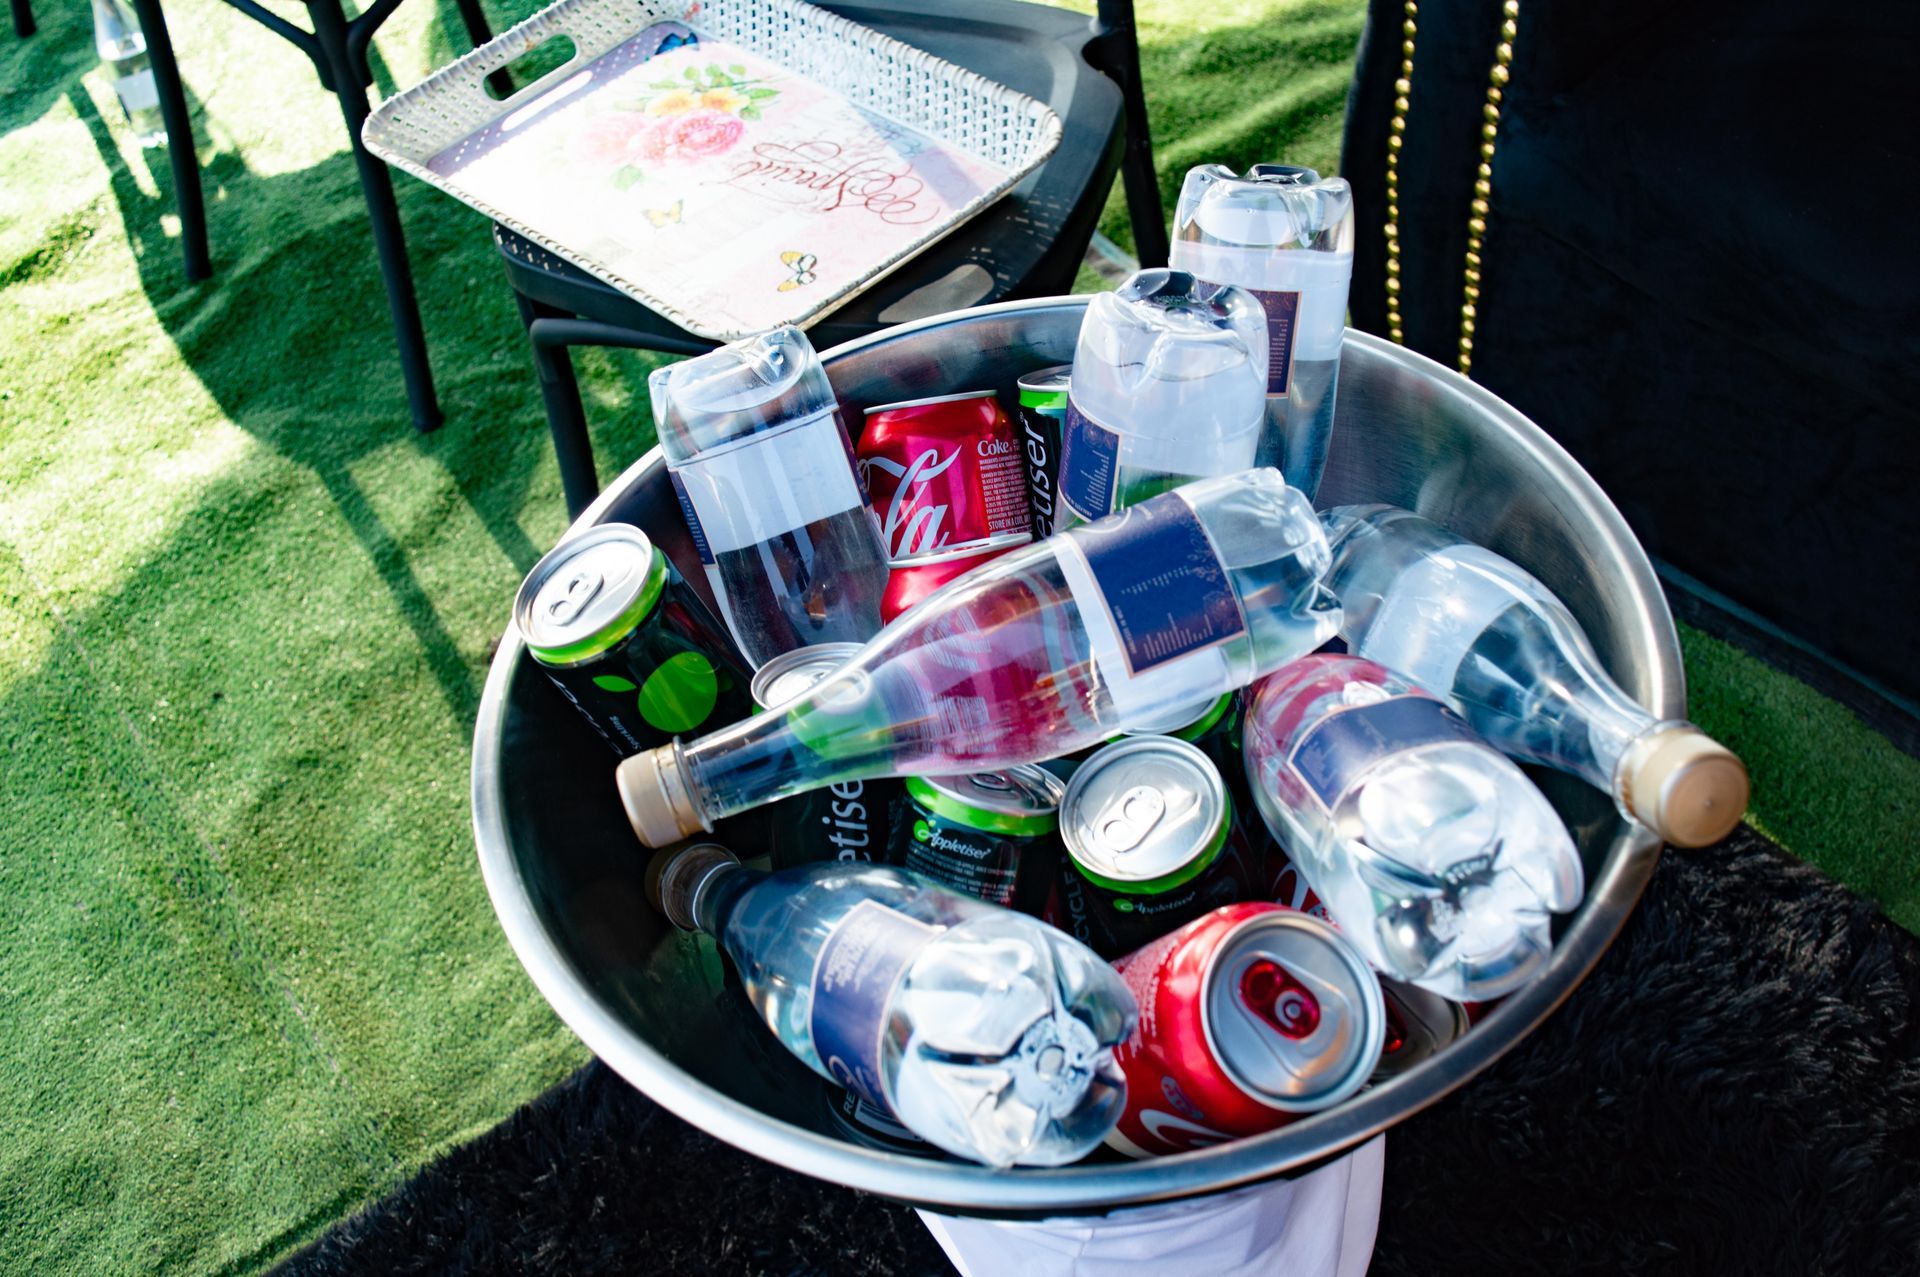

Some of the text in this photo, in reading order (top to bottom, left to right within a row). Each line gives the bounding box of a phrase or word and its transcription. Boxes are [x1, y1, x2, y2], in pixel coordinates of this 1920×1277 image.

[977, 439, 1009, 457] Coke
[1024, 418, 1056, 540] etiser
[988, 519, 1006, 530] STORE
[821, 778, 870, 862] etise
[917, 828, 992, 860] Appletiser
[1063, 869, 1091, 947] CYCLE
